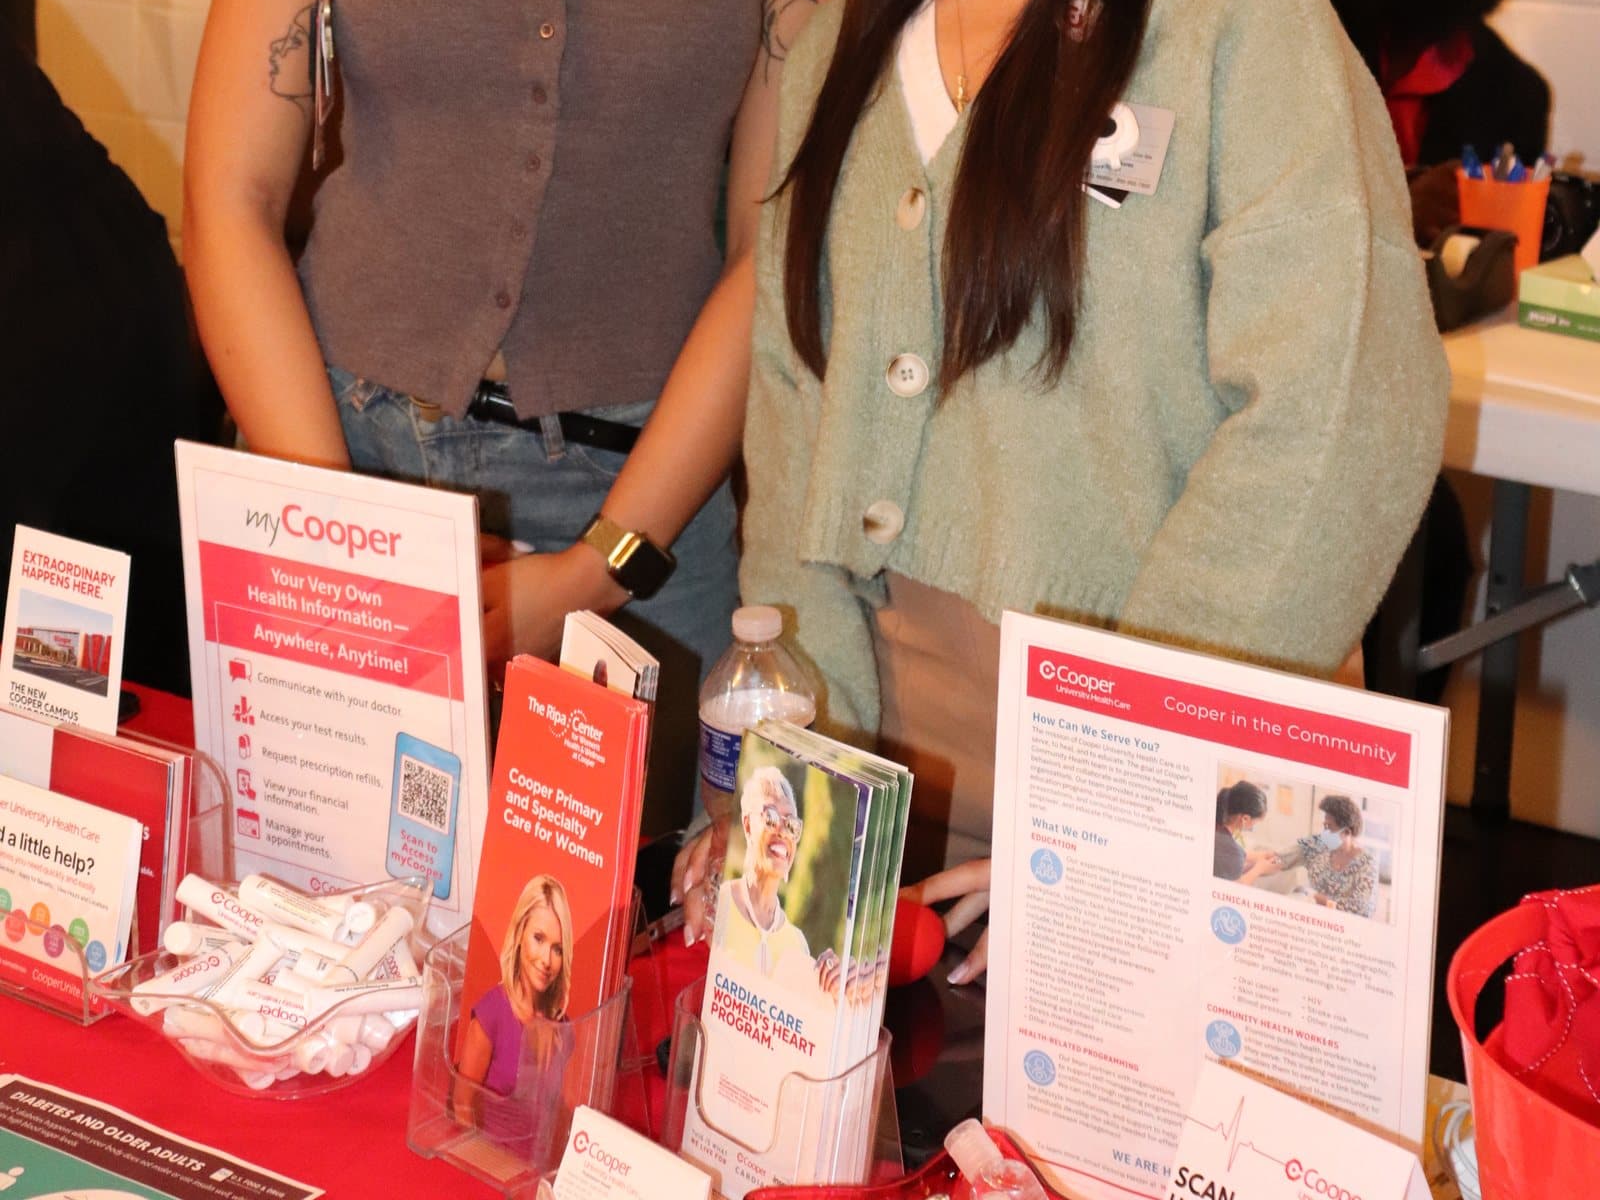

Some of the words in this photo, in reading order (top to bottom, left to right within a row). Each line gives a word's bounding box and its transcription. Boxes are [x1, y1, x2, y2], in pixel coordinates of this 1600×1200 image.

[246, 504, 402, 559] myCooper
[22, 566, 70, 590] HAPPENS
[72, 578, 104, 600] HERE.
[23, 550, 116, 588] EXTRAORDINARY
[271, 568, 304, 592] Your
[308, 575, 342, 602] Very
[346, 583, 382, 607] Own
[248, 585, 297, 611] Health
[254, 624, 334, 660] Anywhere,
[337, 645, 408, 675] Anytime!
[11, 682, 26, 695] THE
[27, 686, 47, 700] NEW
[257, 671, 321, 697] Communicate
[323, 688, 344, 703] with
[347, 695, 368, 712] your
[1055, 684, 1089, 700] University
[1091, 693, 1112, 706] Health
[1114, 699, 1131, 711] Care
[1056, 664, 1115, 697] Cooper
[10, 692, 42, 710] COOPER
[44, 701, 78, 721] CAMPUS
[259, 709, 288, 726] Access
[290, 718, 311, 734] your
[314, 723, 332, 737] test
[528, 696, 545, 715] The
[546, 703, 566, 727] Ripa
[572, 716, 603, 742] Center
[1032, 711, 1055, 726] How
[1058, 718, 1078, 731] Can
[1081, 724, 1097, 737] We
[1100, 728, 1130, 745] Serve
[1134, 737, 1159, 753] You?
[1163, 694, 1225, 725] Cooper
[1231, 710, 1246, 728] in
[1252, 715, 1282, 736] the
[1287, 723, 1396, 766] Community
[261, 746, 296, 766] Request
[299, 757, 353, 782] prescription
[263, 777, 285, 792] View
[287, 786, 307, 801] your
[309, 789, 348, 810] financial
[508, 767, 554, 800] Cooper
[556, 788, 603, 826] Primary
[10, 800, 52, 828] University
[52, 818, 80, 835] Health
[81, 827, 100, 844] Care
[265, 817, 302, 839] Manage
[303, 830, 324, 846] your
[506, 790, 528, 810] and
[531, 800, 587, 841] Specialty
[1031, 816, 1058, 832] What
[1062, 824, 1077, 838] We
[1081, 830, 1108, 847] Offer
[8, 832, 16, 847] a
[19, 834, 50, 860] little
[54, 847, 94, 876] help?
[400, 828, 424, 848] Scan
[426, 842, 438, 854] to
[401, 842, 434, 865] Access
[503, 808, 531, 833] Care
[534, 824, 552, 843] for
[555, 830, 604, 868] Women
[1031, 832, 1076, 851] EDUCATION
[224, 898, 263, 928] Coope
[1211, 891, 1250, 908] CLINICAL
[1253, 902, 1286, 918] HEALTH
[1289, 912, 1344, 933] SCREENINGS
[257, 1004, 307, 1027] Cooper
[714, 986, 769, 1030] WOMEN'S
[772, 1022, 815, 1057] HEART
[715, 972, 766, 1014] CARDIAC
[770, 1006, 804, 1034] CARE
[710, 1002, 774, 1051] PROGRAM.
[1207, 1004, 1257, 1025] COMMUNITY
[1260, 1020, 1293, 1036] HEALTH
[1295, 1030, 1338, 1049] WORKERS
[1018, 1027, 1081, 1053] HEALTH-RELATED
[1083, 1047, 1138, 1072] PROGRAMMING
[10, 1091, 74, 1118] DIABETES
[69, 1107, 106, 1131] AND
[104, 1124, 150, 1152] OLDER
[148, 1143, 206, 1172] ADULTS
[589, 1142, 632, 1178] Cooper
[742, 1156, 765, 1177] Cooper
[1112, 1148, 1130, 1165] WE
[1135, 1156, 1158, 1174] ARE
